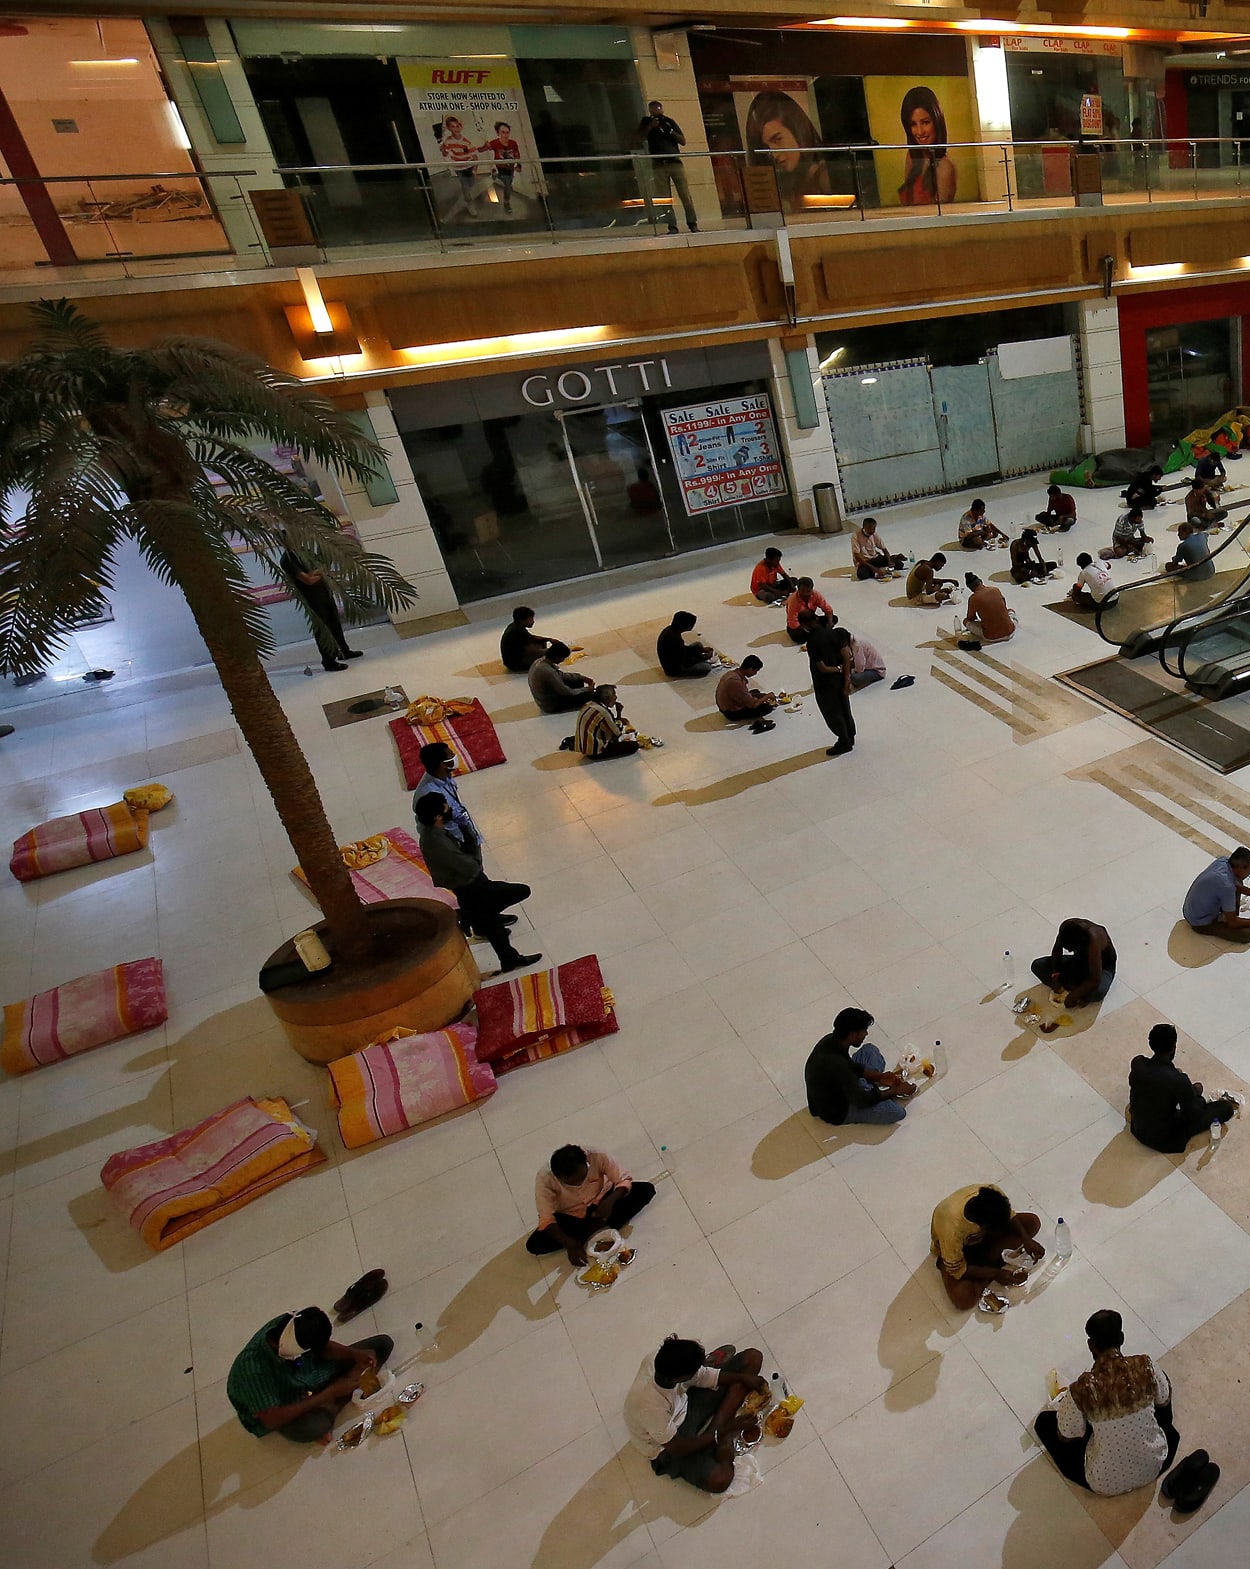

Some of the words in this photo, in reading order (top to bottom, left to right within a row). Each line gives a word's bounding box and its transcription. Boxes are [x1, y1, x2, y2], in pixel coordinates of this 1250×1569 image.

[1043, 39, 1064, 47] CLAP
[432, 70, 491, 84] RUFF
[1200, 75, 1237, 85] TRENDS
[428, 92, 448, 100] STORE
[521, 359, 672, 407] GOTTI
[729, 414, 746, 423] Any
[749, 411, 767, 419] One
[755, 422, 766, 435] 2
[687, 434, 699, 447] 2
[698, 442, 722, 451] Jeans
[760, 442, 770, 455] 3
[694, 455, 706, 468] 2
[707, 463, 727, 472] Shirt
[685, 474, 724, 488] Rs.999/-
[739, 467, 757, 477] Any
[759, 464, 778, 472] One
[756, 477, 764, 487] 2
[706, 485, 716, 497] 4
[726, 482, 736, 493] 5
[703, 498, 720, 506] Shirt
